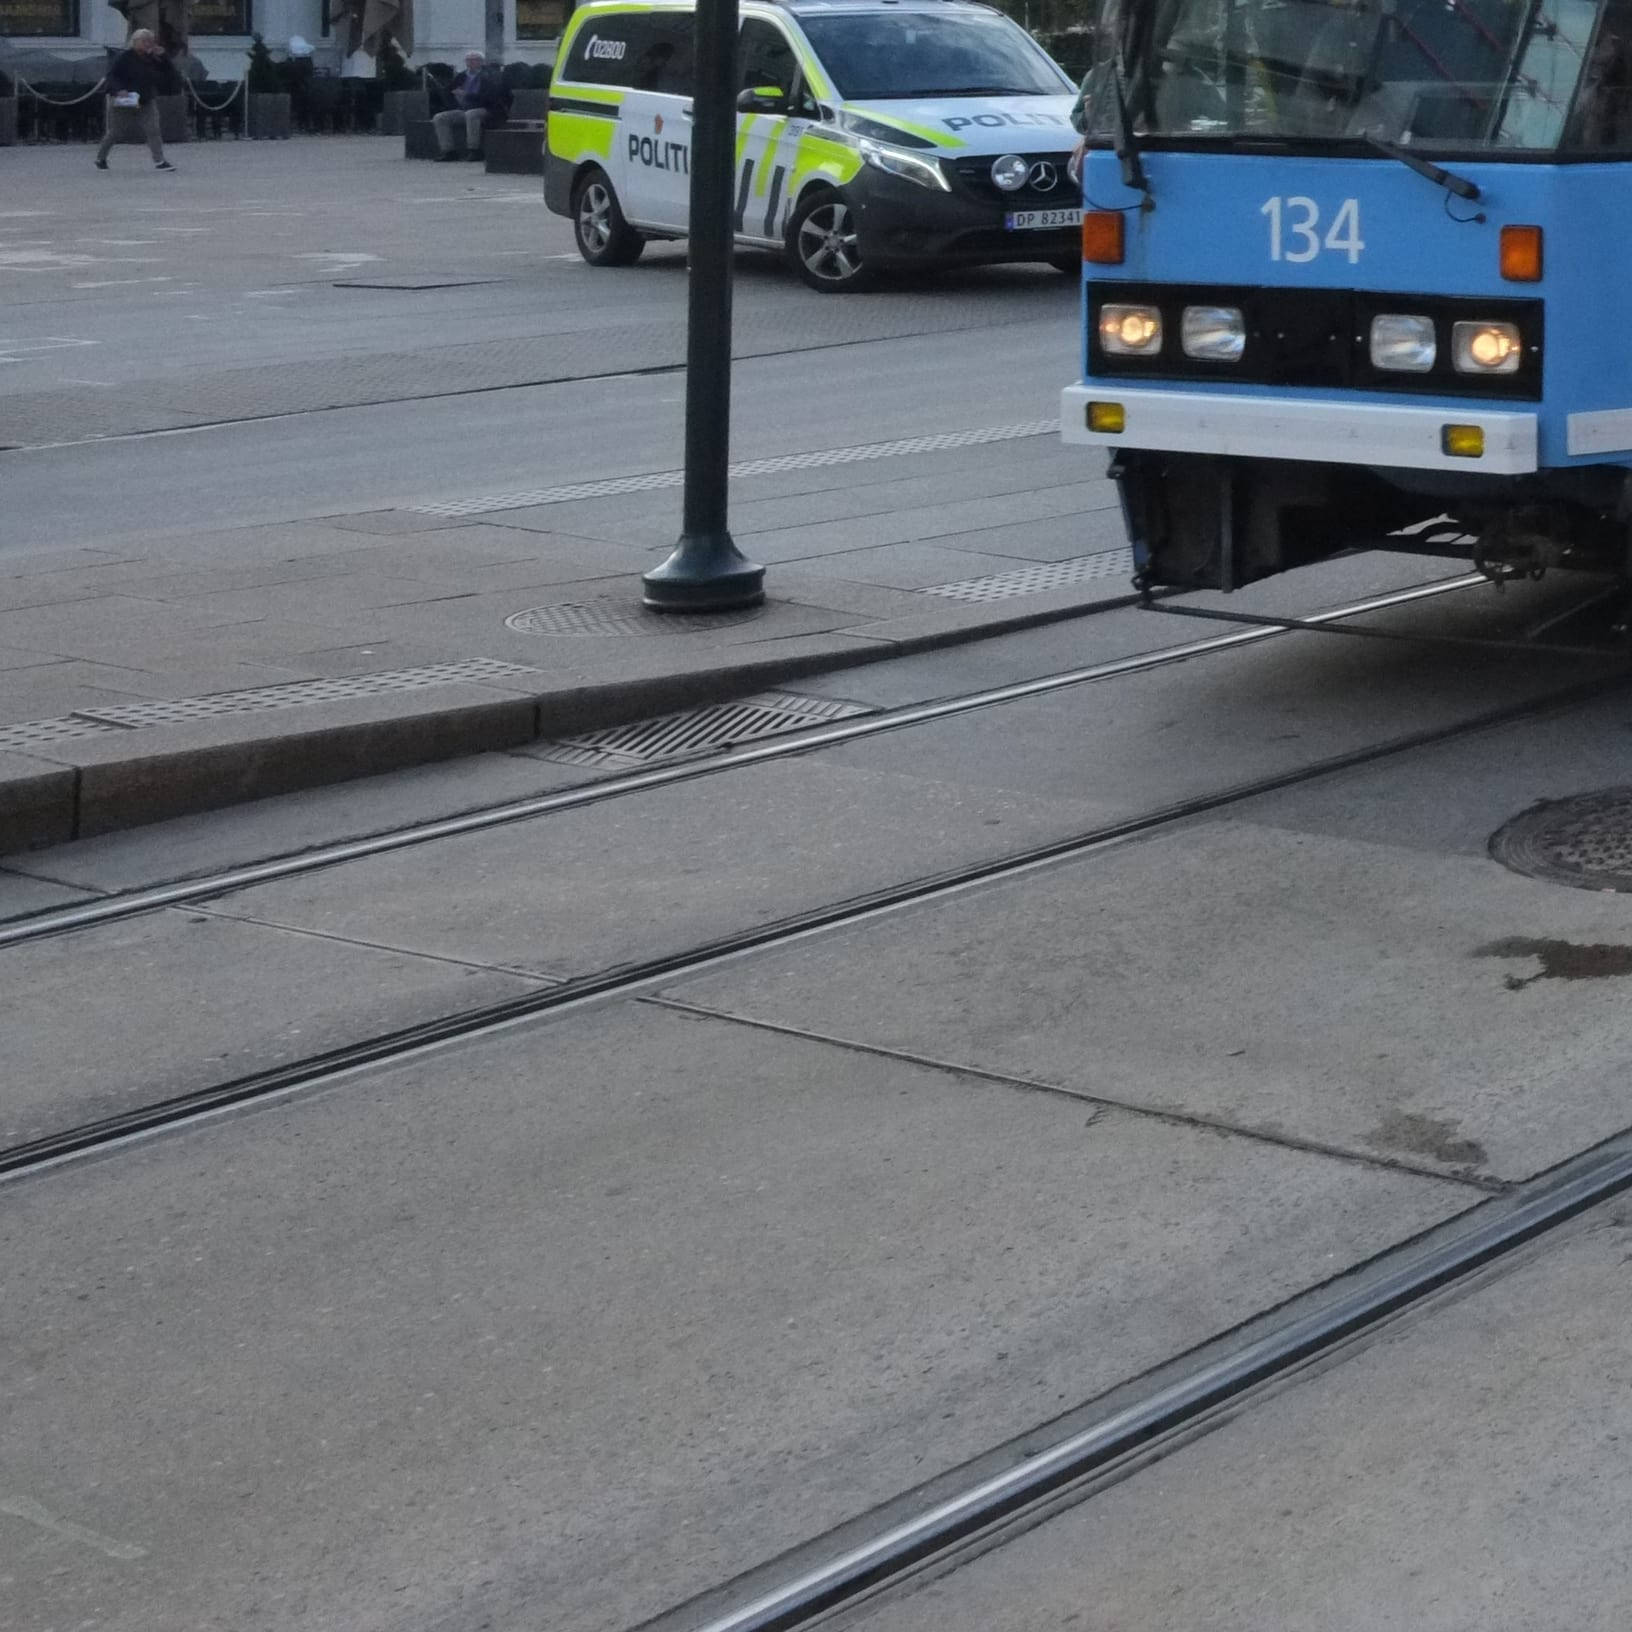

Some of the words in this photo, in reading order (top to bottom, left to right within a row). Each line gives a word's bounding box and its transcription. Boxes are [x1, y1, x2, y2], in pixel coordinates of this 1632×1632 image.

[593, 40, 626, 60] 02800
[629, 134, 689, 175] POLITI
[1016, 214, 1035, 226] DP
[1260, 196, 1366, 264] 134
